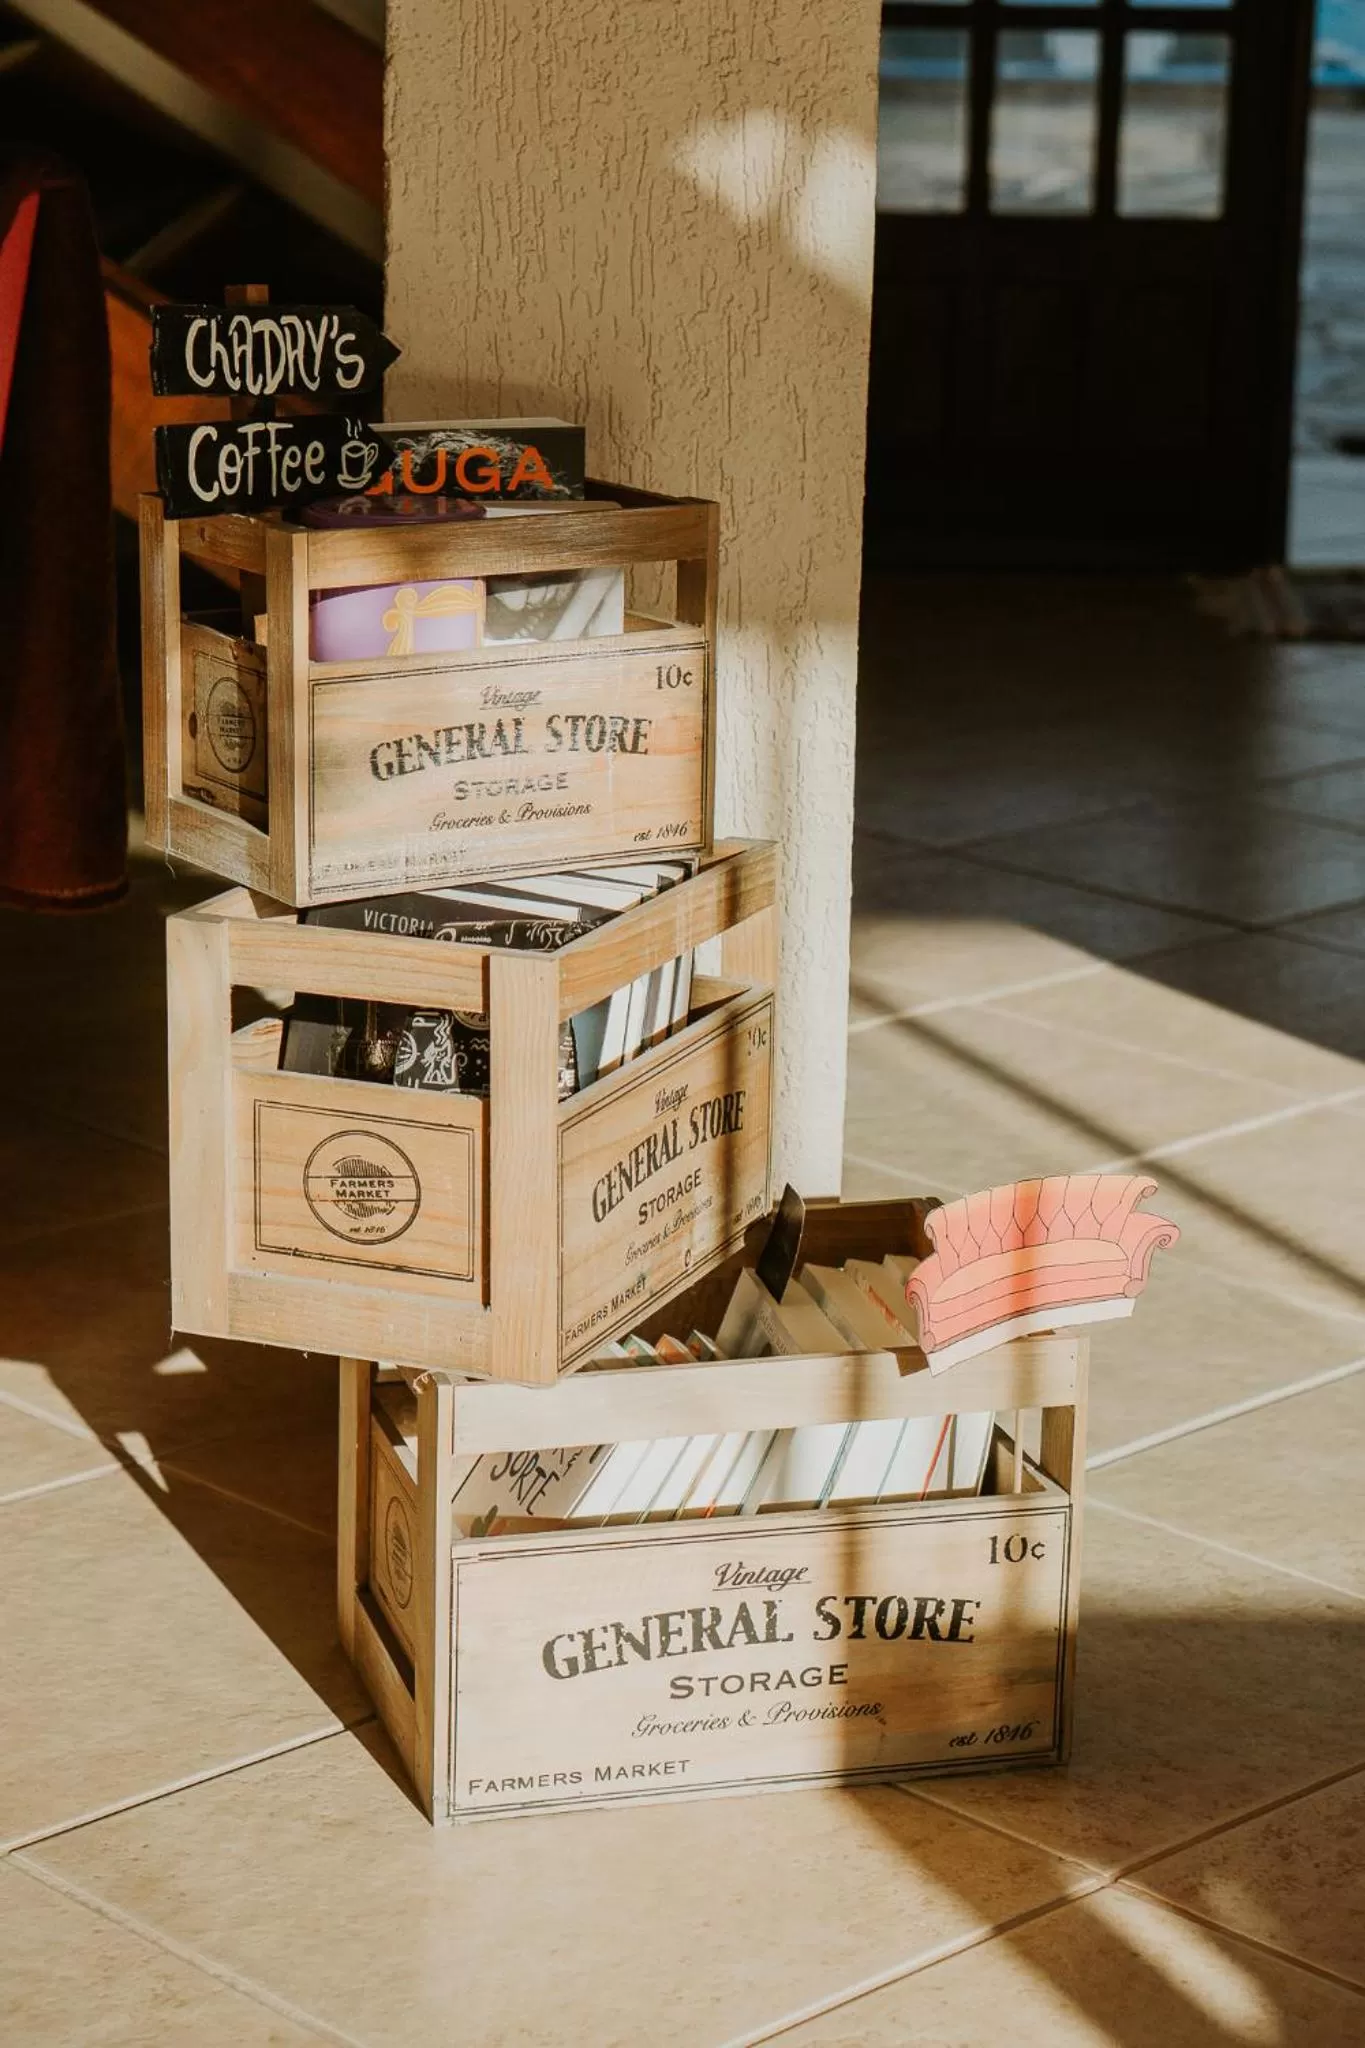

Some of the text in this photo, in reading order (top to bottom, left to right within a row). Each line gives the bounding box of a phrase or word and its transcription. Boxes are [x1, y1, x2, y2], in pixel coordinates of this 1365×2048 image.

[370, 714, 652, 781] GENERAL STORE
[454, 772, 568, 800] STORAGE
[429, 801, 592, 831] Groceries & Provisions
[364, 908, 434, 937] VICTORIA
[592, 1090, 746, 1223] GENERAL STORE
[330, 1179, 395, 1189] FARMERS
[335, 1189, 390, 1199] MARKET
[638, 1168, 702, 1226] STORAGE
[565, 1273, 646, 1342] FARMERS MARKET
[714, 1561, 809, 1592] Vintage
[542, 1595, 982, 1680] GENERAL STORE
[669, 1663, 849, 1700] STORAGE
[631, 1700, 878, 1740] Groceries & Provisions
[468, 1759, 691, 1796] FARMERS MARKET
